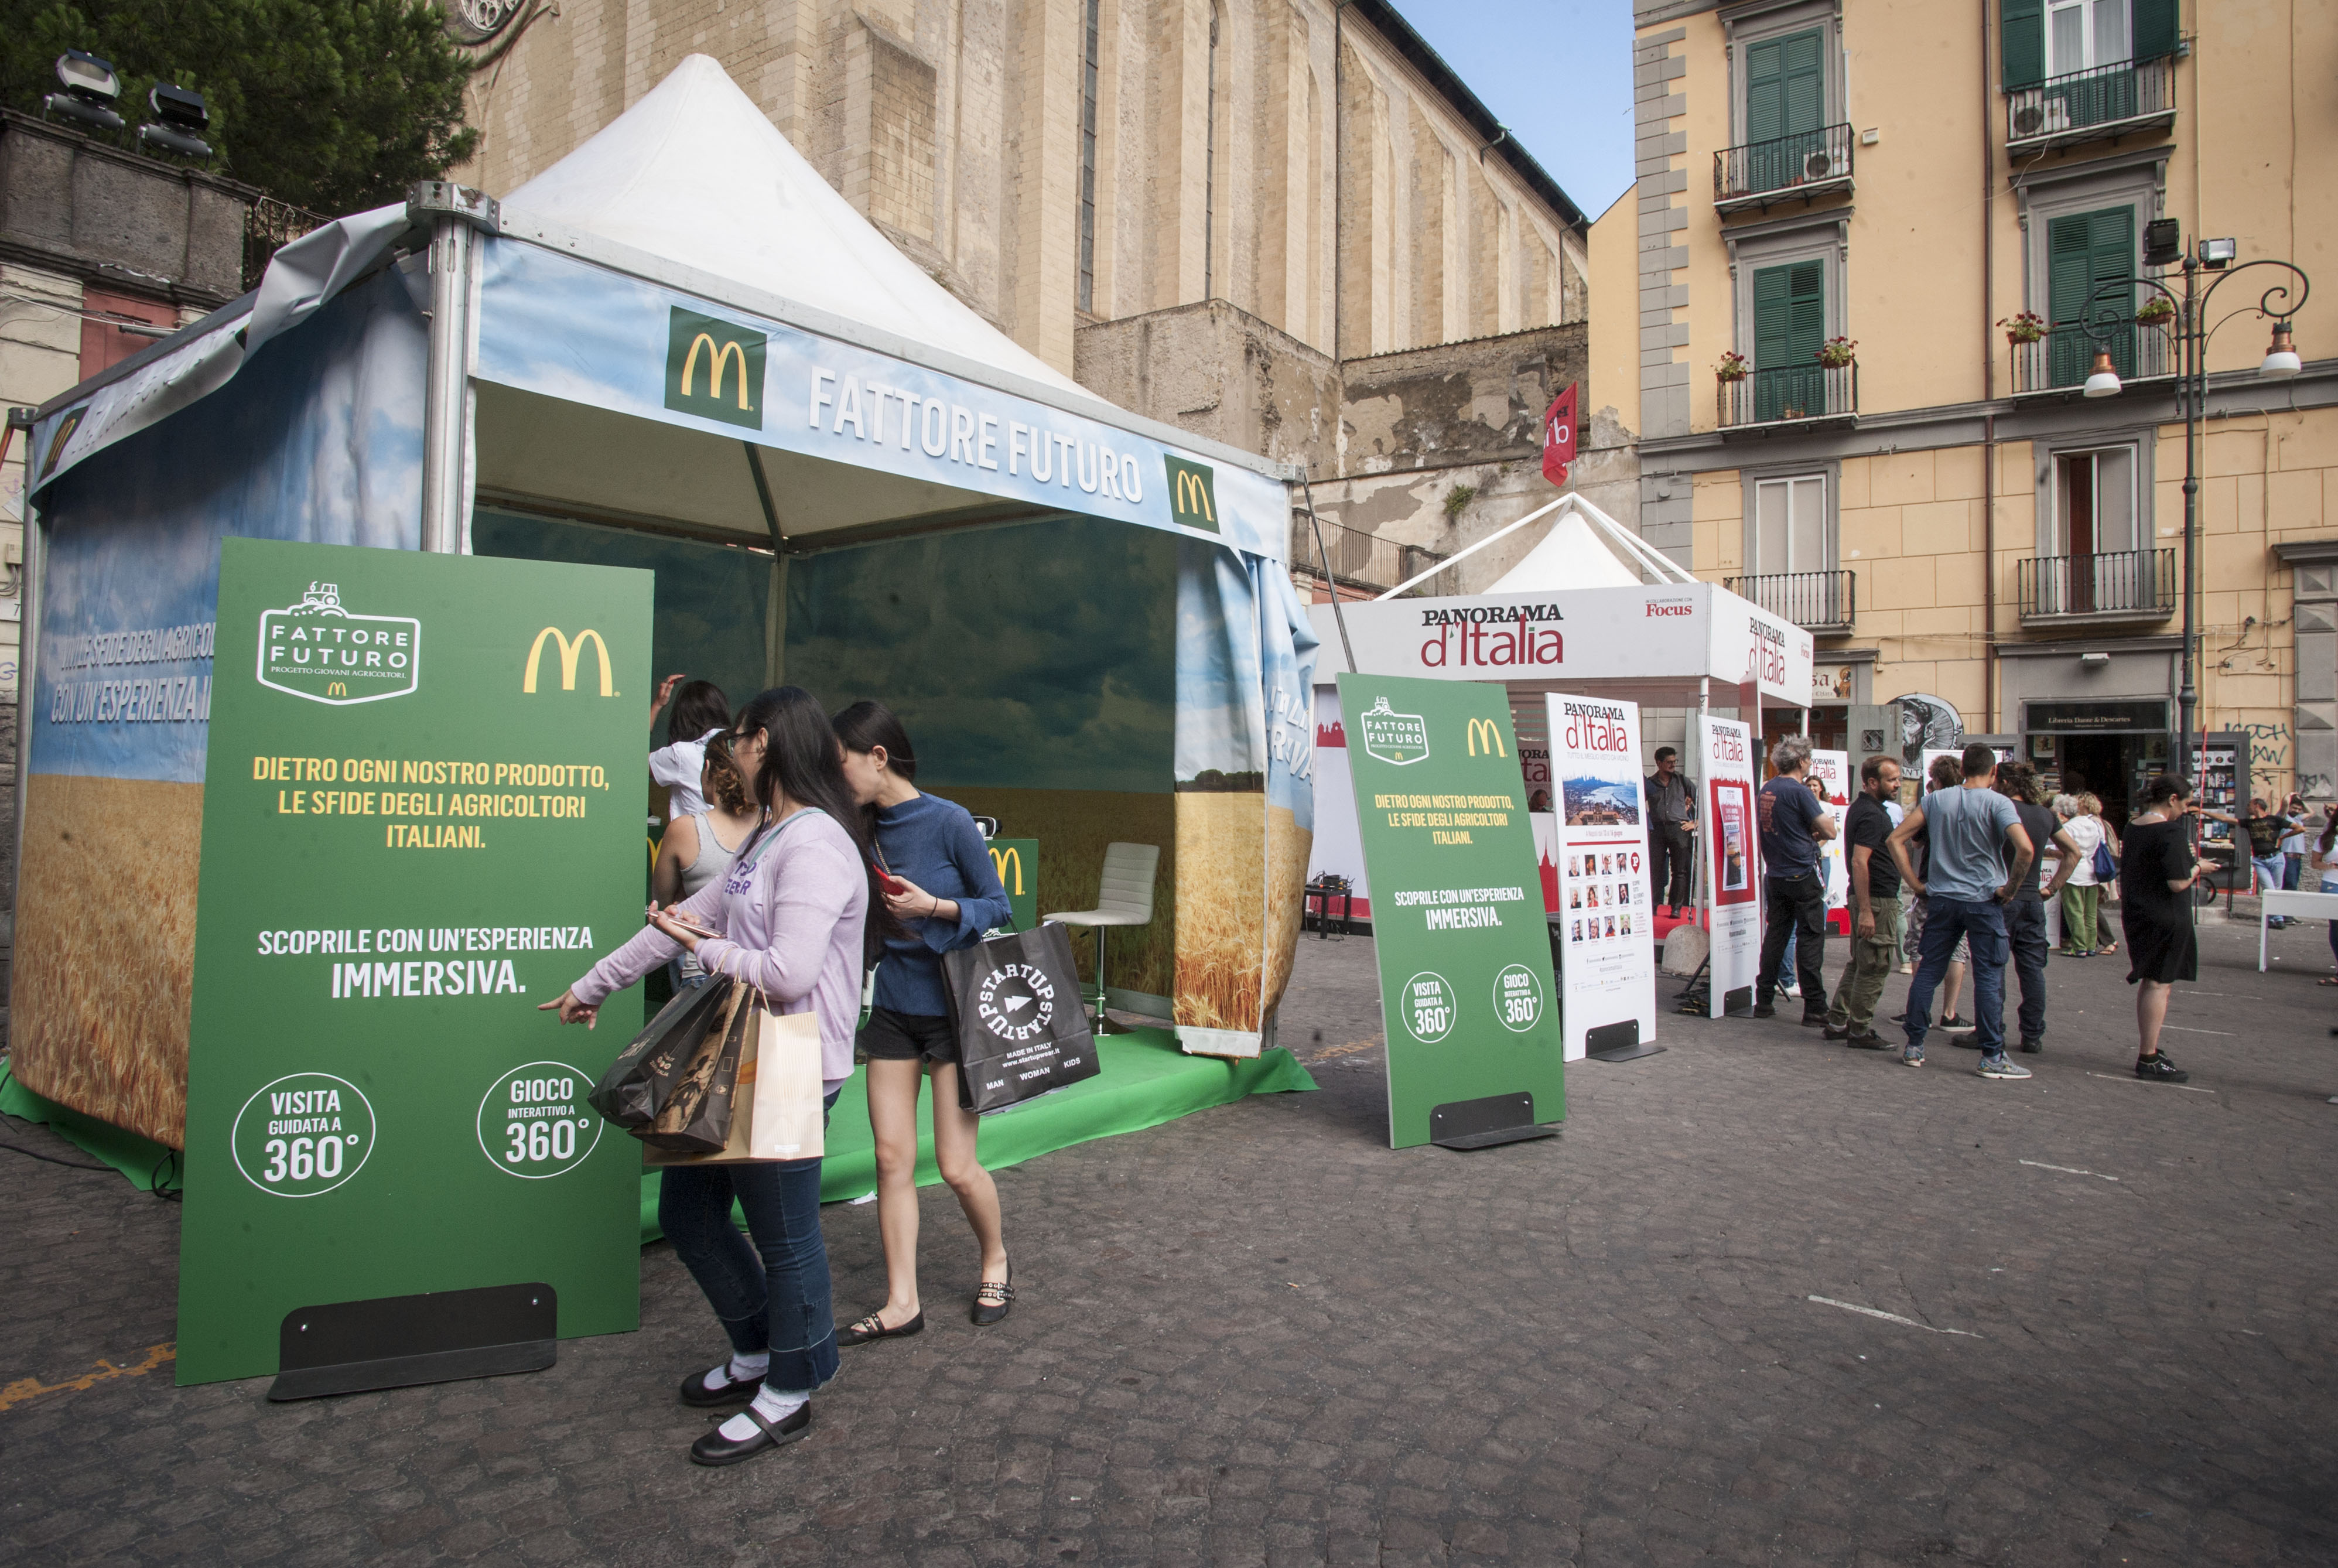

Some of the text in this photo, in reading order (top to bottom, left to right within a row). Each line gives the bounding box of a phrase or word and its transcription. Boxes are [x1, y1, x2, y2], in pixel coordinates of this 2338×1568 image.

[809, 364, 1143, 504] FATTORE FUTURO
[1421, 604, 1564, 626] PANORAMA
[1645, 603, 1693, 617] Focus
[272, 625, 408, 647] FATTORE
[1420, 613, 1564, 667] d'Italia
[1749, 616, 1786, 648] PANORAMA
[91, 632, 128, 667] SFIDE
[125, 628, 165, 664] DEGLI
[271, 646, 408, 668] FUTURO
[271, 666, 313, 674] PROGETTO
[314, 668, 350, 676] GIOVANI
[52, 683, 78, 723] CON
[76, 676, 197, 722] UN'ESPERIENZA
[1564, 702, 1625, 721] PANORAMA
[1366, 721, 1421, 732] FATTORE
[1565, 712, 1628, 753] d'Italia
[1711, 724, 1742, 739] PANORAMA
[1368, 732, 1423, 744] FUTURO
[253, 756, 610, 791] DIETRO OGNI NOSTRO PRODOTTO,
[278, 790, 586, 818] LE SFIDE DEGLI AGRICOLTORI
[1375, 794, 1515, 810] DIETRO OGNI NOSTRO PRODOTTO,
[1387, 812, 1509, 826] LE SFIDE DEGLI AGRICOLTORI
[386, 824, 486, 849] ITALIANI.
[1433, 831, 1473, 845] ITALIANI.
[1394, 887, 1525, 906] SCOPRILE CON UN'ESPERIENZA
[1425, 906, 1503, 930] IMMERSIVA.
[257, 926, 594, 955] SCOPRILE CON UN'ESPERIENZA
[331, 959, 526, 999] IMMERSIVA.
[1413, 981, 1441, 997] VISITA
[1503, 973, 1529, 989] GIOCO
[1414, 996, 1443, 1008] GUIDATA A
[1505, 996, 1537, 1023] 360°
[1414, 1006, 1451, 1035] 360°
[1002, 1047, 1060, 1068] www.startupwear.it
[1006, 1047, 1026, 1059] MADE
[1034, 1041, 1052, 1053] ITALY
[1019, 1066, 1051, 1081] WOMAN
[1063, 1057, 1081, 1068] KIDS
[510, 1077, 574, 1104] GIOCO
[986, 1079, 1004, 1090] MAN
[270, 1089, 342, 1116] VISITA
[507, 1104, 576, 1119] INTERATTIVO A
[268, 1116, 342, 1135] GUIDATA A
[505, 1118, 589, 1163] 360°
[264, 1133, 360, 1182] 360°
